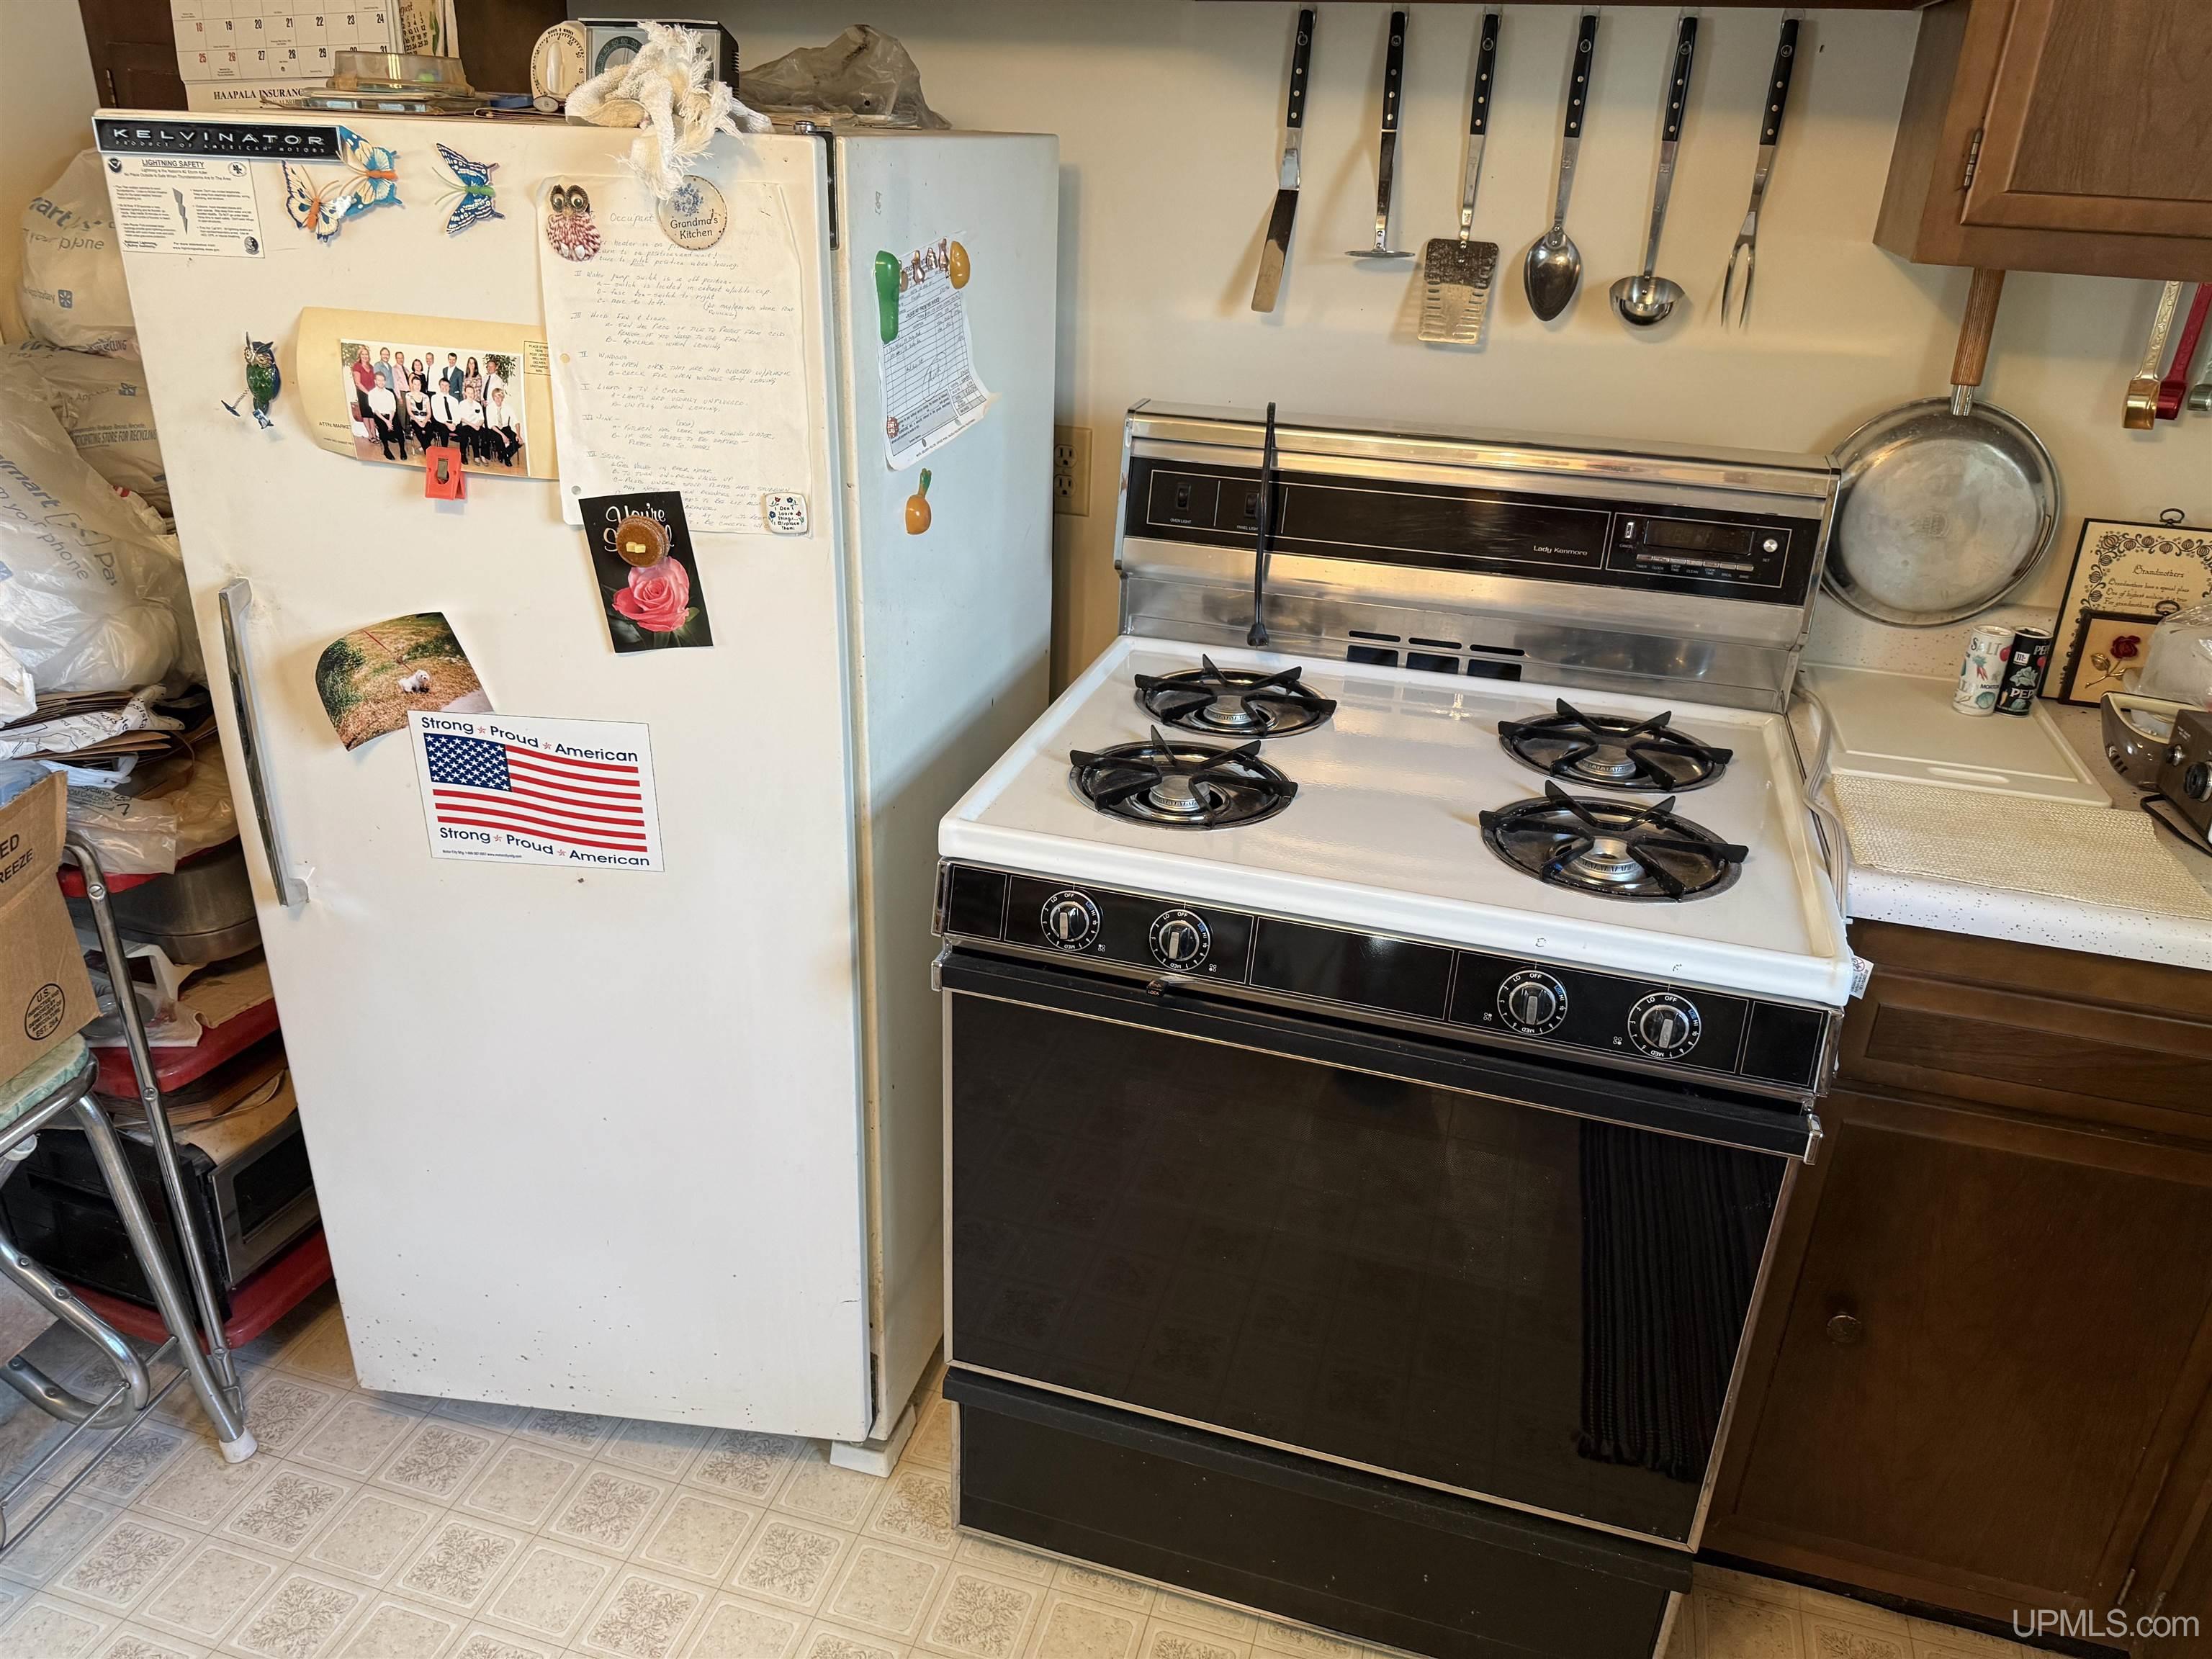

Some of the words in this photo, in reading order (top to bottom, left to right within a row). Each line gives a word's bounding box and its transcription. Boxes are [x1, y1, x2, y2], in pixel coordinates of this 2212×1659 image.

[196, 22, 203, 32] 18
[225, 20, 233, 31] 19
[254, 19, 262, 30] 20
[286, 17, 294, 28] 21
[315, 16, 324, 27] 22
[347, 15, 355, 25] 23
[377, 14, 385, 24] 24
[199, 53, 207, 63] 25
[228, 52, 236, 62] 26
[258, 50, 265, 60] 27
[288, 49, 296, 60] 28
[319, 48, 327, 58] 29
[214, 90, 256, 100] HAAPALA
[259, 88, 303, 98] INSURANC
[113, 128, 325, 145] KELVINATOR
[670, 215, 719, 229] Grandma's
[680, 229, 713, 240] Kitchen
[0, 454, 60, 508] lmart
[1533, 544, 1552, 554] Lady
[1554, 546, 1588, 556] Kenmore
[2132, 564, 2184, 578] Grandmothers
[1971, 637, 2002, 656] SALT
[421, 716, 474, 735] Strong
[490, 726, 539, 748] Proud
[555, 743, 638, 763] American
[439, 827, 491, 845] Strong
[506, 834, 554, 855] Proud
[569, 850, 650, 866] American
